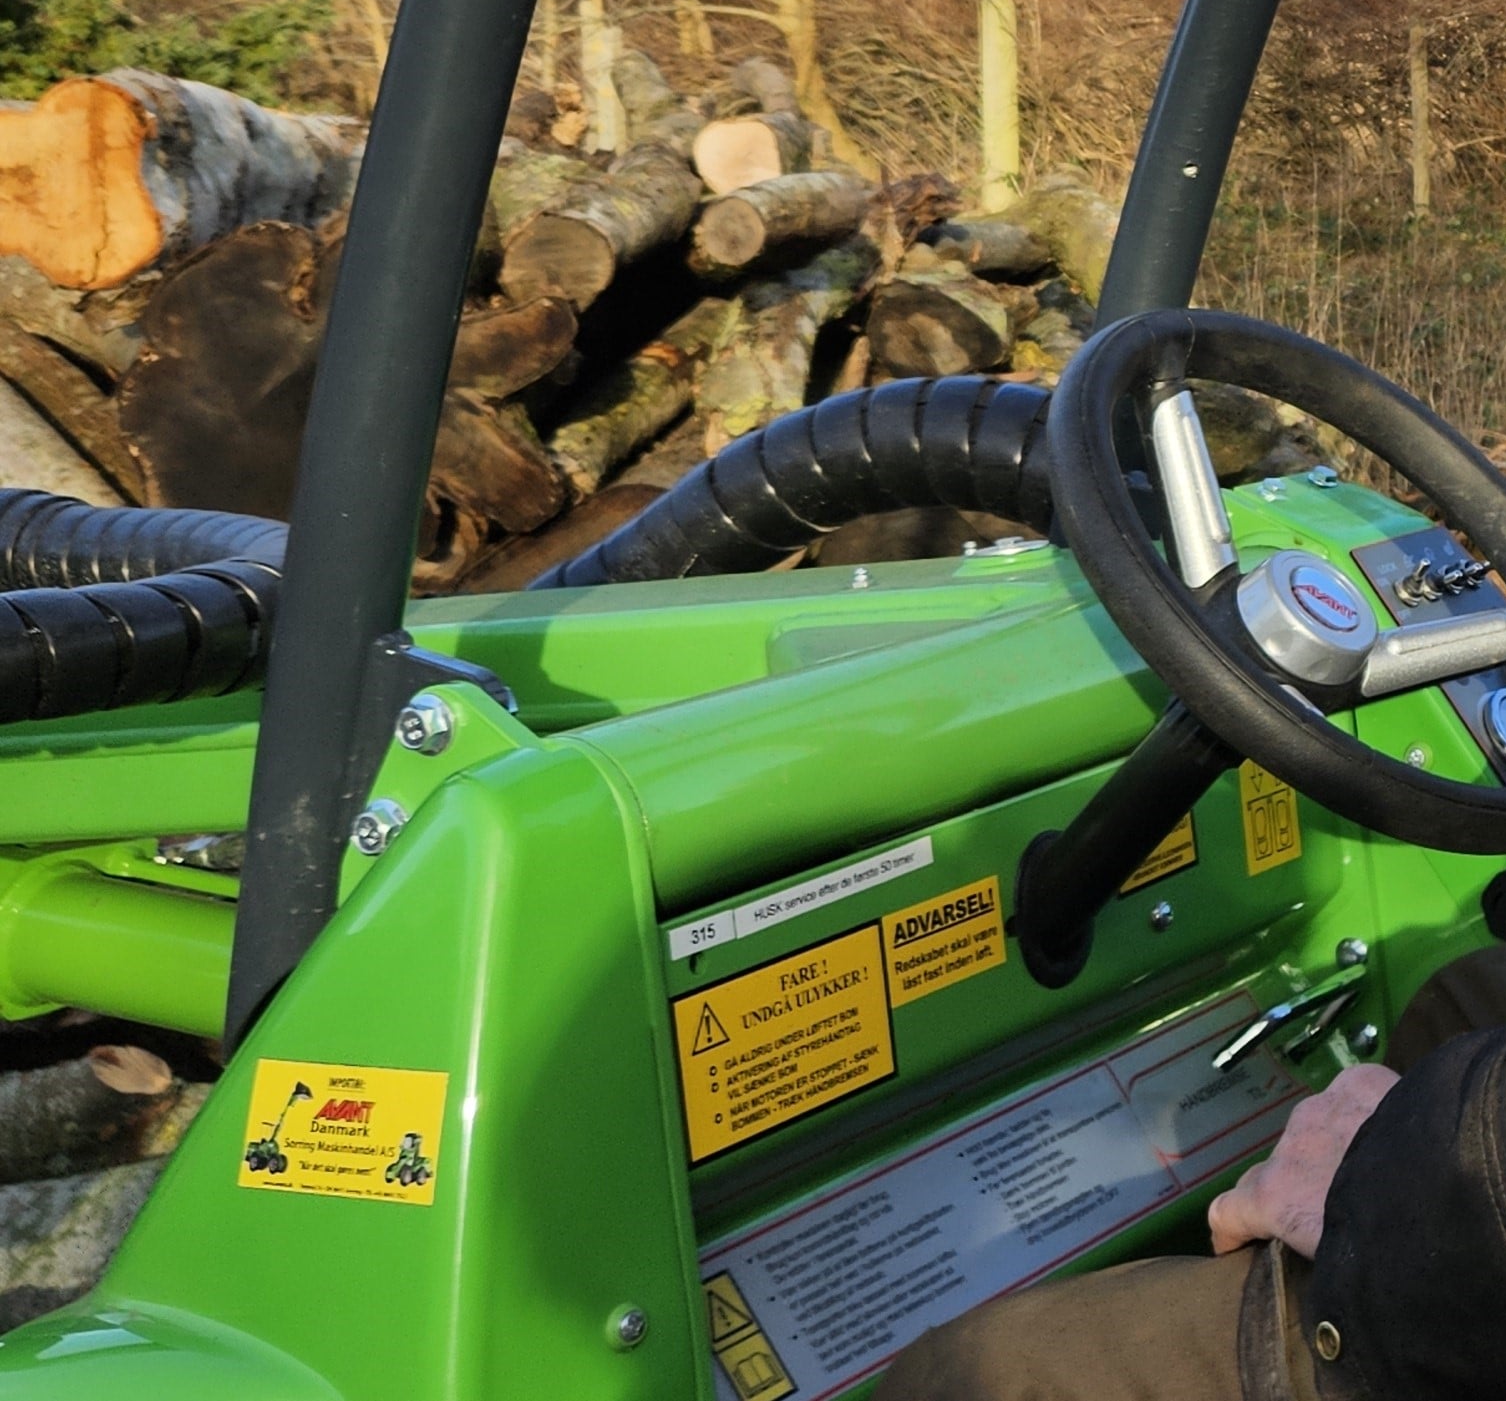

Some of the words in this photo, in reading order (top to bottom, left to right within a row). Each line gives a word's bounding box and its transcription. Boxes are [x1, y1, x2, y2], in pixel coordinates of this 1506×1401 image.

[754, 901, 782, 921] HUSK
[784, 891, 817, 910] service
[818, 882, 839, 898] efter
[840, 876, 852, 889] de
[880, 859, 893, 874] 50
[691, 924, 716, 945] 315
[894, 888, 994, 943] ADVARSEL!
[895, 944, 949, 975] Redskabet
[950, 935, 971, 953] skal
[973, 926, 998, 942] være
[924, 964, 943, 982] fast
[946, 954, 974, 973] inden
[741, 996, 793, 1030] UNDGÅ
[794, 973, 860, 1009] ULYKKER
[779, 968, 819, 992] FARE
[724, 1055, 739, 1071] GÅ
[740, 1043, 773, 1066] ALDRIG
[774, 1029, 805, 1050] UNDER
[806, 1015, 838, 1037] LØFTET
[839, 1007, 859, 1024] BOM
[727, 1058, 780, 1086] AKTIVERING
[781, 1050, 794, 1064] AF
[794, 1022, 862, 1058] STYREHÅNDTAG
[728, 1087, 742, 1100] VIL
[744, 1072, 777, 1094] SÆNKE
[778, 1064, 798, 1079] BOM
[730, 1099, 750, 1116] NÅR
[751, 1082, 795, 1108] MOTOREN
[796, 1075, 809, 1088] ER
[809, 1058, 849, 1082] STOPPET
[731, 1107, 771, 1132] BOMMEN
[778, 1093, 805, 1111] TRÆK
[805, 1063, 870, 1100] HÅNDBREMSEN
[310, 1121, 371, 1137] Danmark
[313, 1098, 376, 1123] AVANT
[317, 1141, 379, 1156] Maskinhandel
